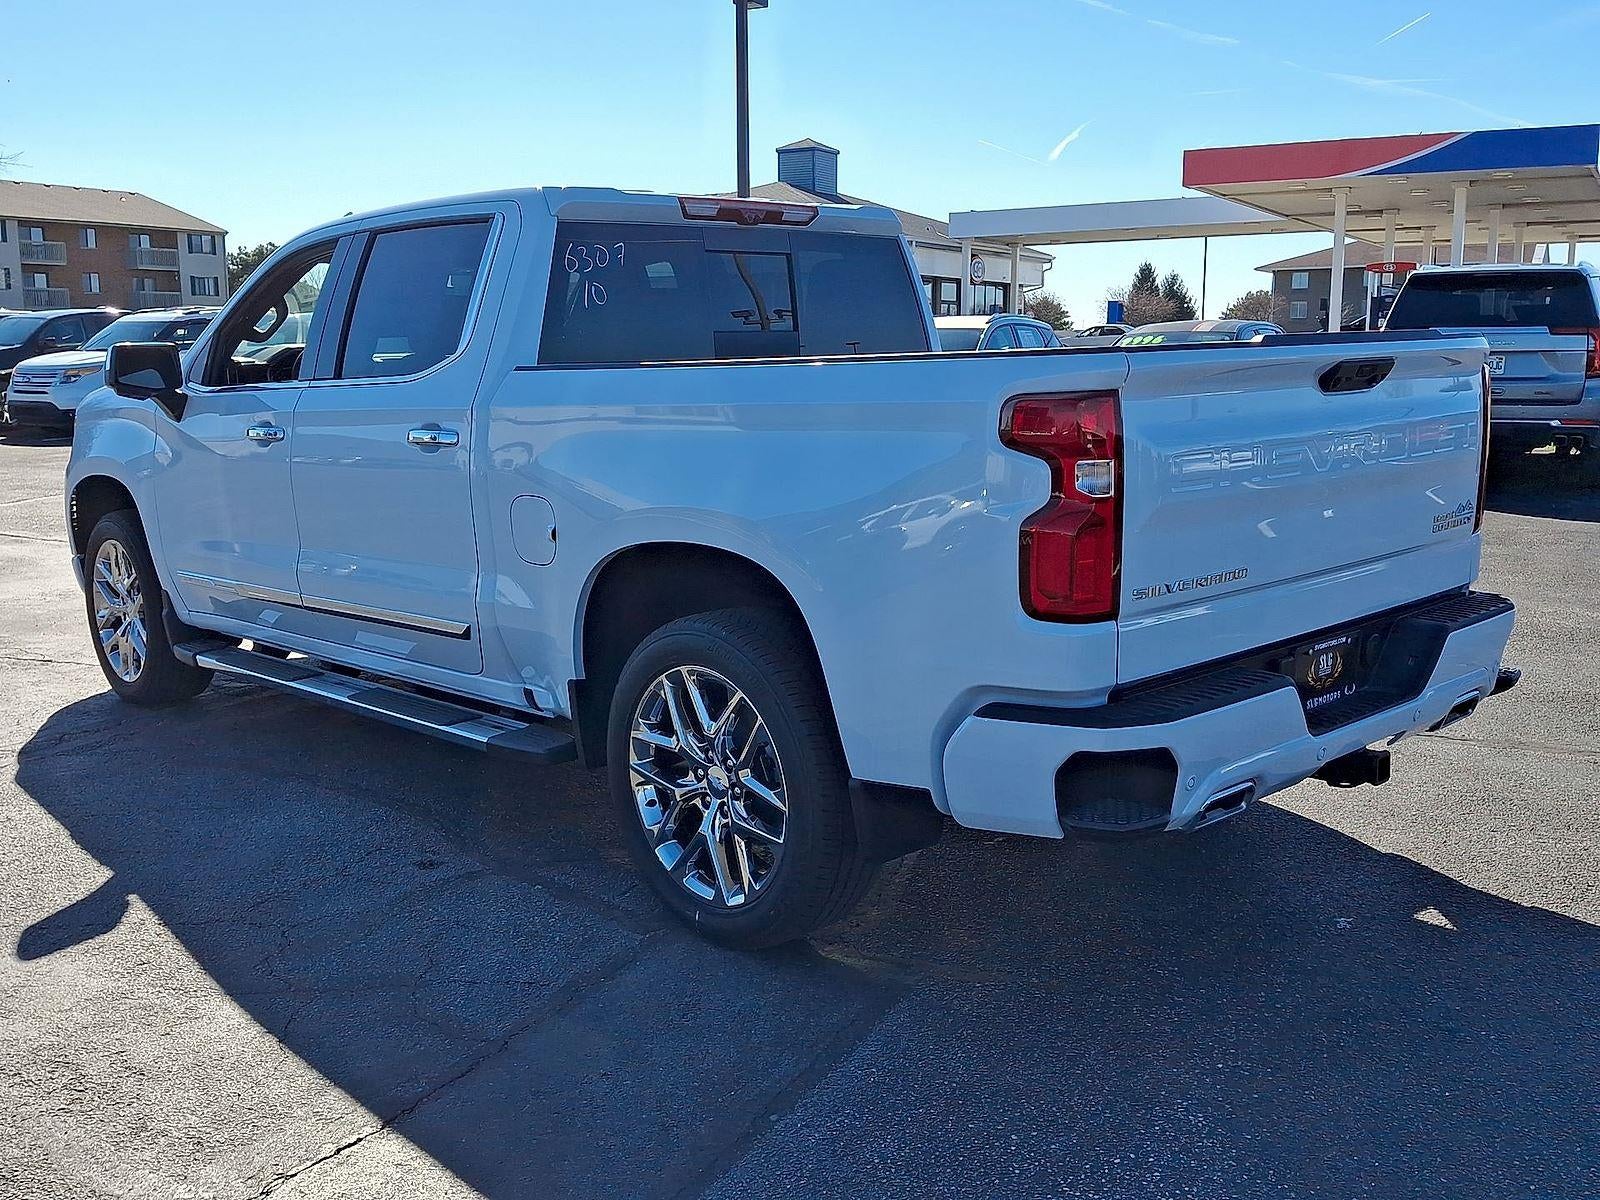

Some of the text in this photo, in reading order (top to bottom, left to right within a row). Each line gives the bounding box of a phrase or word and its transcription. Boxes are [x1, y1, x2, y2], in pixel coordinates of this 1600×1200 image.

[565, 242, 625, 273] 6307
[584, 280, 608, 309] 10
[1131, 566, 1248, 601] SILVERADO
